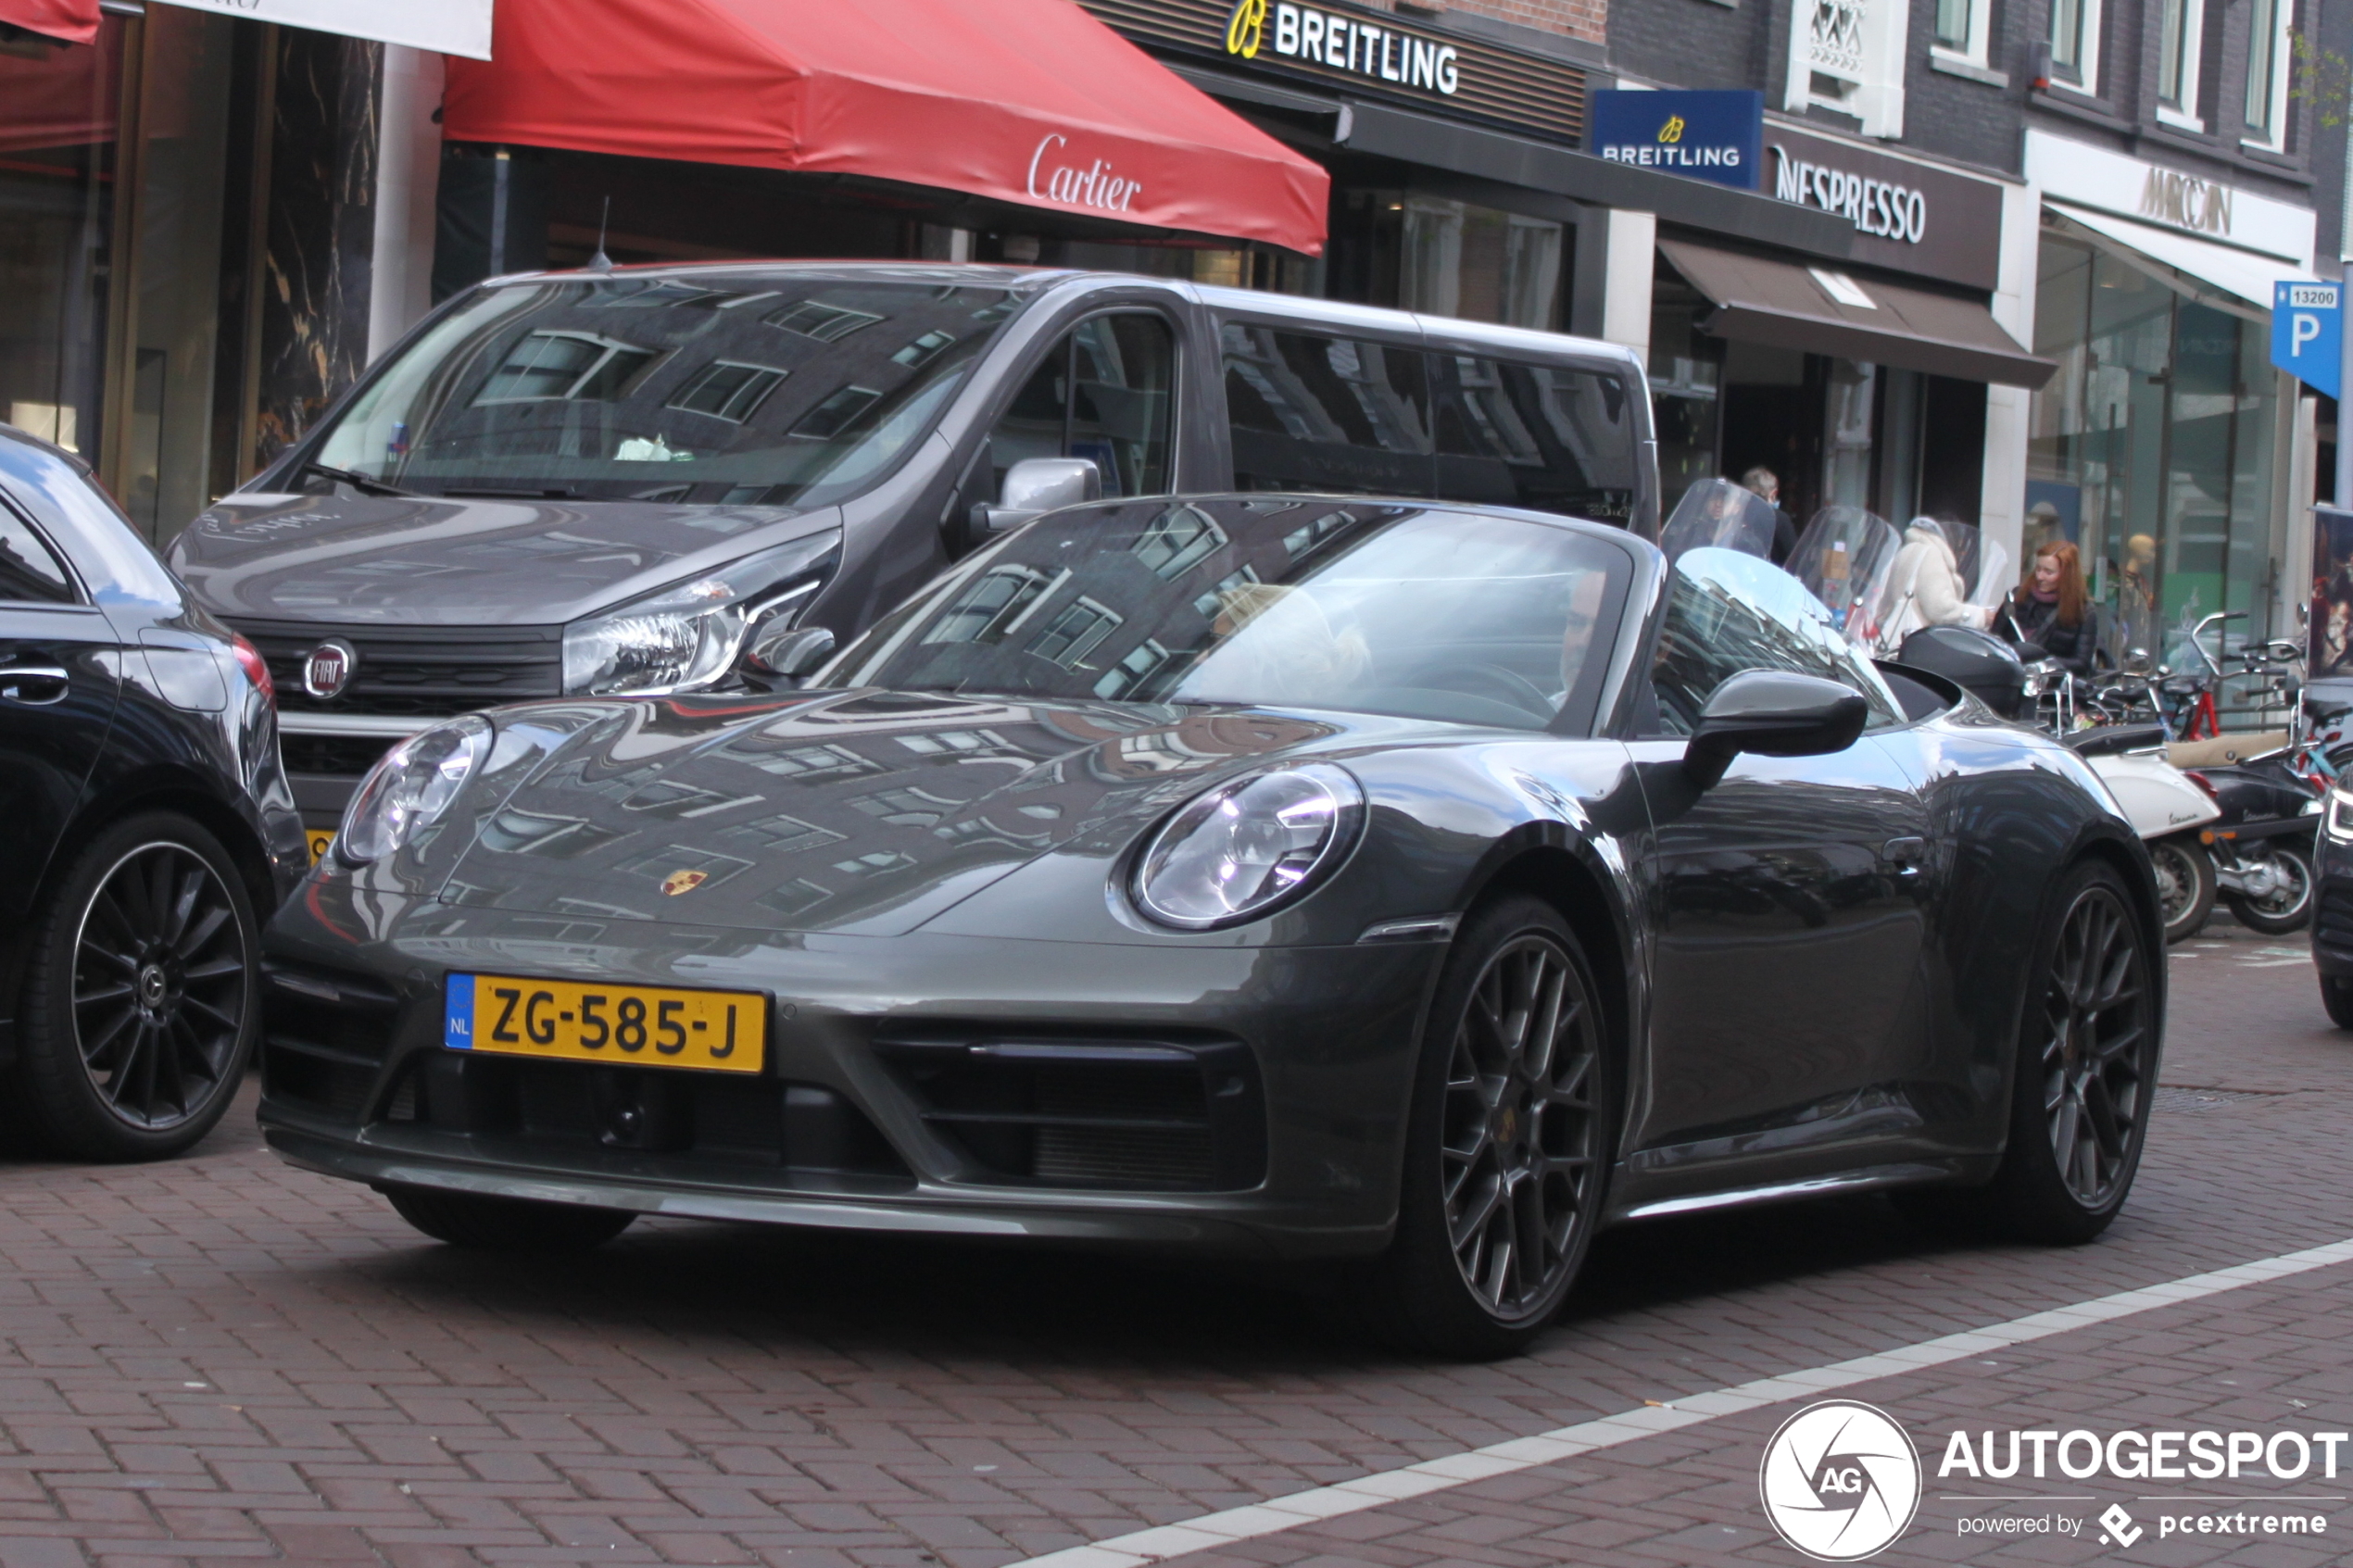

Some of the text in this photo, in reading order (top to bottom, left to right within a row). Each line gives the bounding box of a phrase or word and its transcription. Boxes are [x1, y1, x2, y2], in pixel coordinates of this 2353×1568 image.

[1274, 4, 1459, 94] BREITLING
[1027, 133, 1142, 212] Cartier
[1603, 145, 1740, 167] BREITLING
[1771, 144, 1926, 244] NESPRESSO
[2294, 291, 2334, 305] 13200
[2291, 313, 2321, 358] P
[312, 659, 341, 684] FIAT
[450, 1017, 470, 1036] NL
[491, 987, 737, 1060] ZG-585-J
